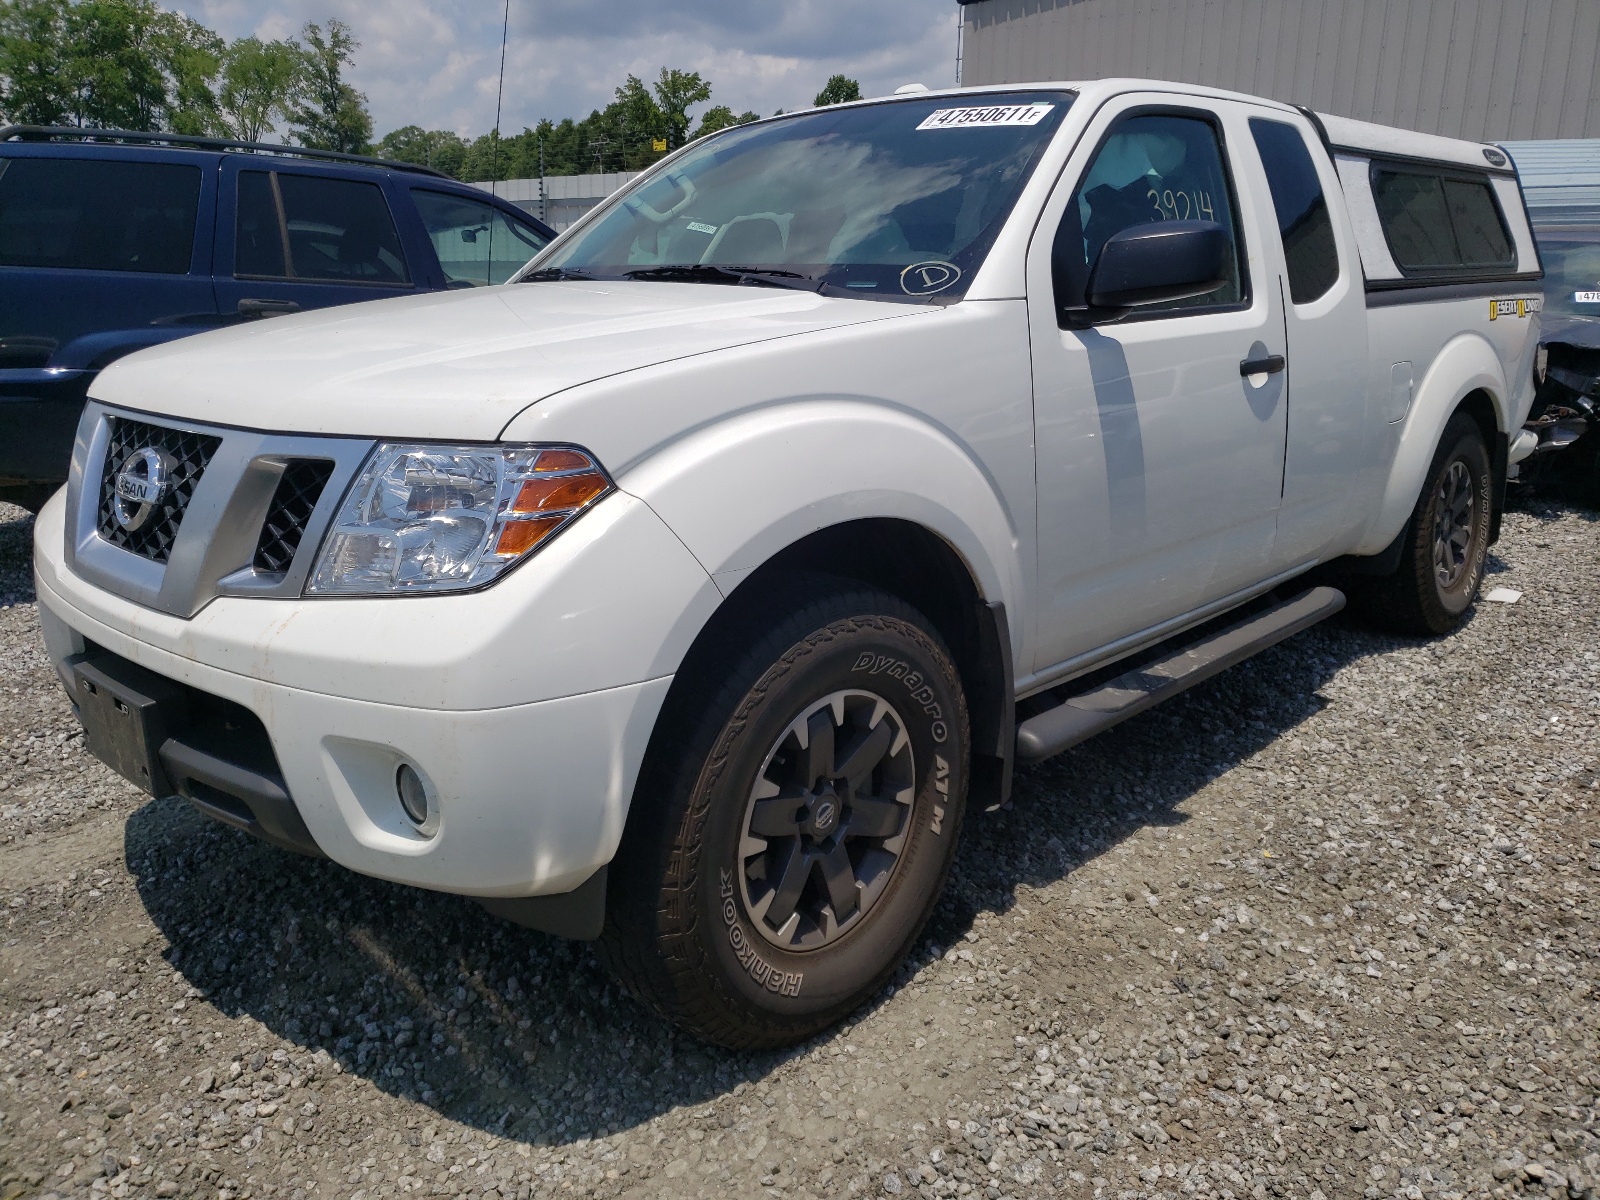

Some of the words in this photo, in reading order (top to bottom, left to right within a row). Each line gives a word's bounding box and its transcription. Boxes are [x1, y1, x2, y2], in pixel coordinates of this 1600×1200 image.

[937, 106, 1034, 125] 47550611
[1490, 299, 1517, 321] DESERT
[851, 651, 949, 743] Dynapro
